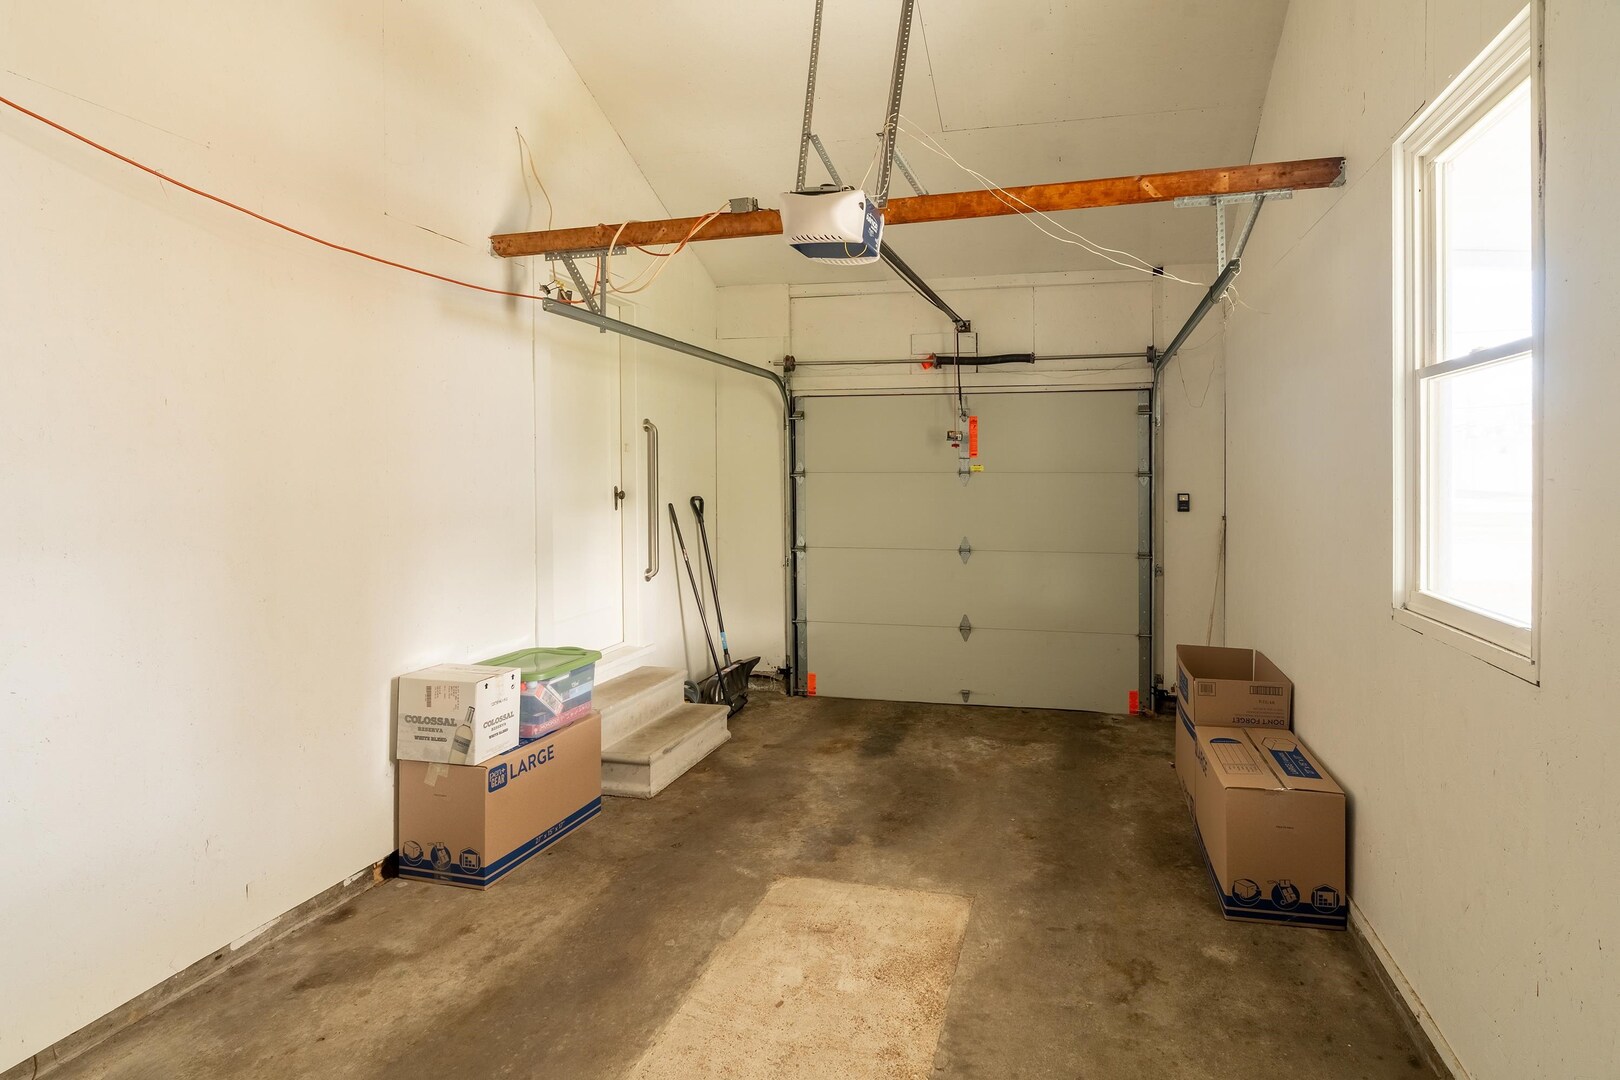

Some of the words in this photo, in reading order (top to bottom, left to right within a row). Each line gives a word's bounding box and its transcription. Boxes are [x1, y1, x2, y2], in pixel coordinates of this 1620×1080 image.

[404, 714, 457, 727] COLOSSAL
[483, 711, 515, 729] COLOSSAL
[1263, 718, 1285, 726] DON'T
[510, 744, 555, 780] LARGE
[490, 774, 505, 788] GEAR
